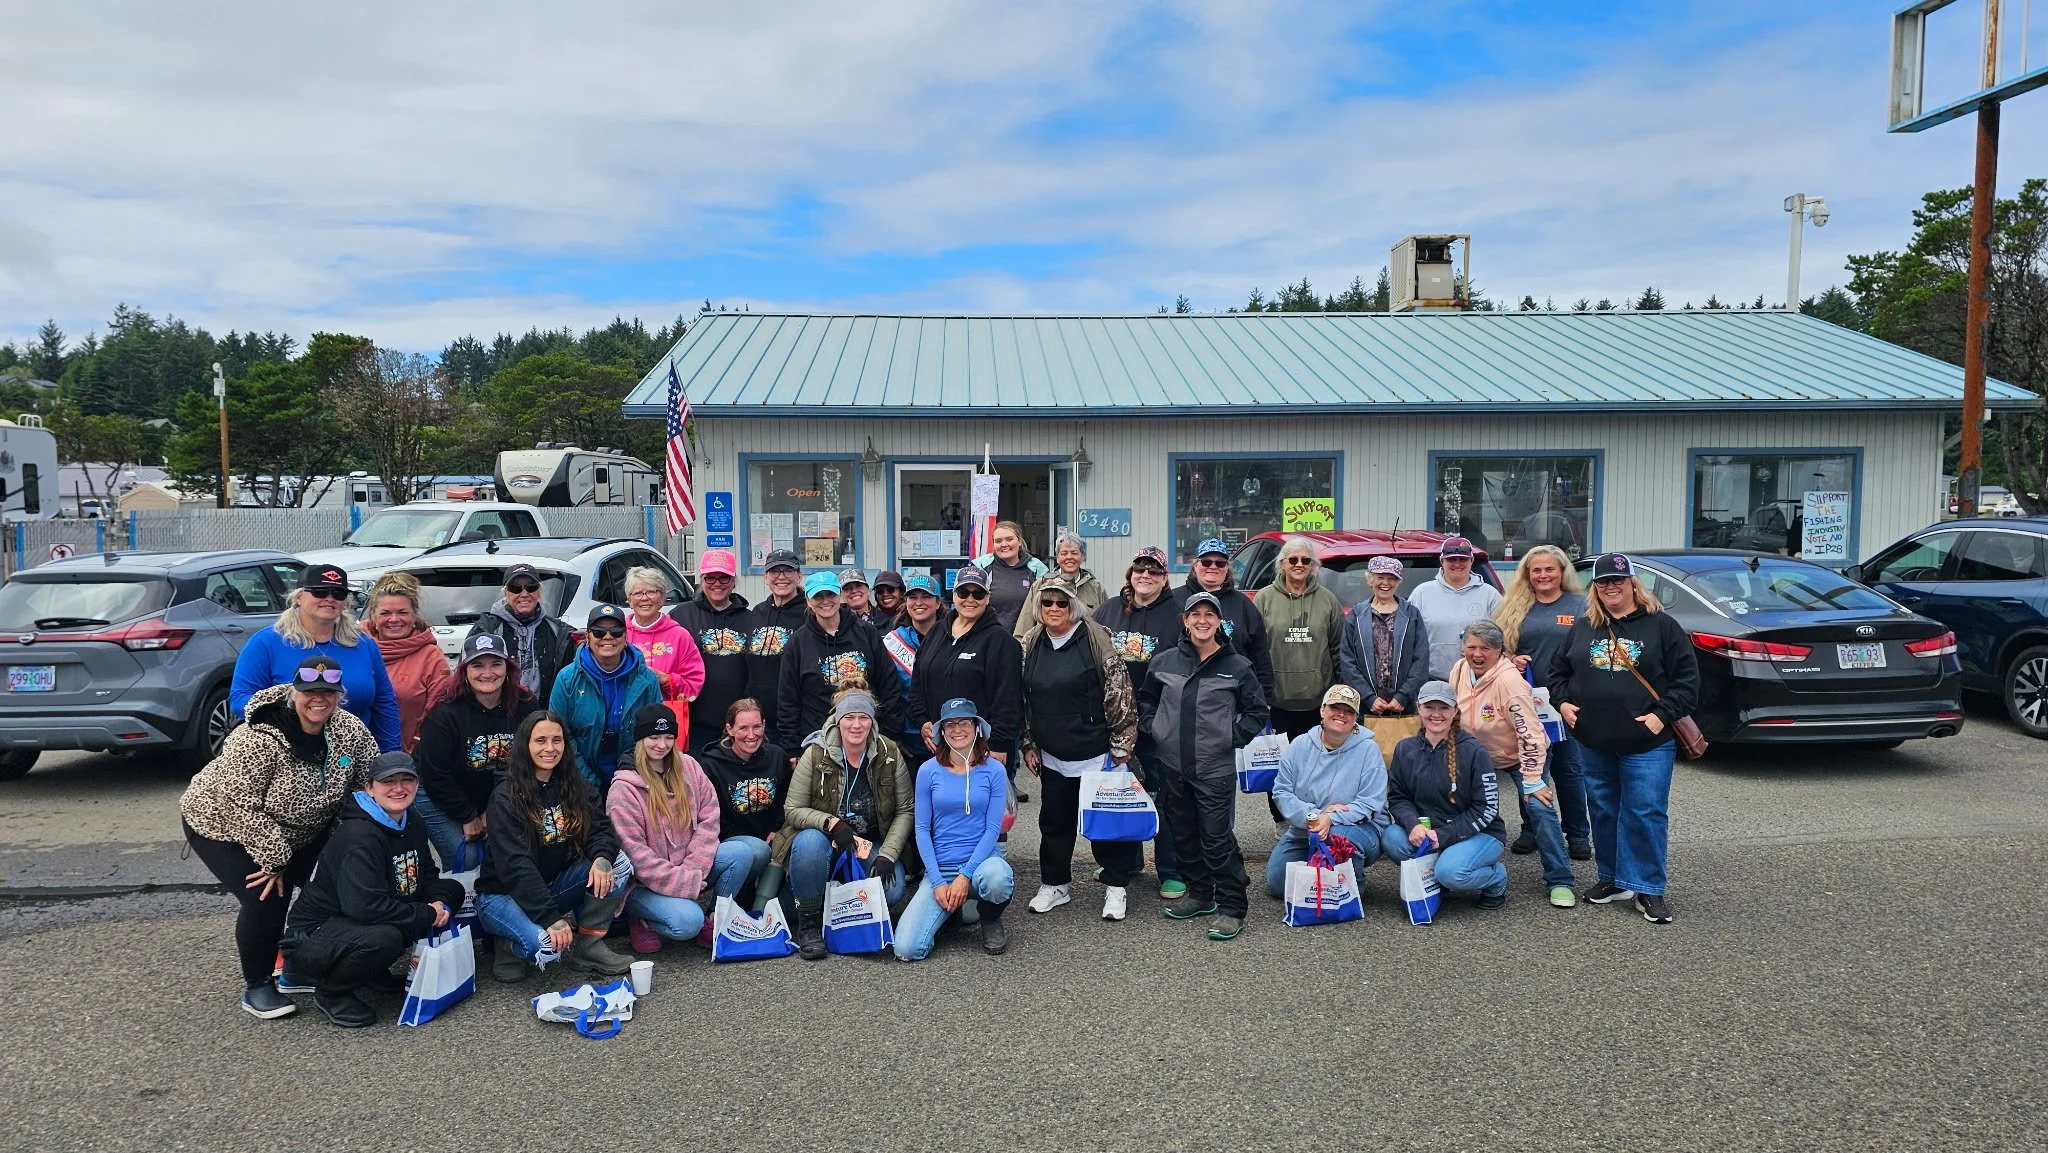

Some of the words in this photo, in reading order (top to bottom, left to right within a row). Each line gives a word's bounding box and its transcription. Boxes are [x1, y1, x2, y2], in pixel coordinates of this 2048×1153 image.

[786, 488, 821, 499] Open
[1807, 493, 1848, 507] SUPPORT
[1285, 501, 1335, 523] SUPPORT
[1815, 505, 1837, 516] THE
[1079, 510, 1130, 536] 63480
[1294, 521, 1323, 531] OUR
[1804, 516, 1843, 527] FISHING
[1808, 525, 1846, 535] INDUSTRY
[1805, 535, 1828, 544] VOTE
[1829, 533, 1843, 542] NO
